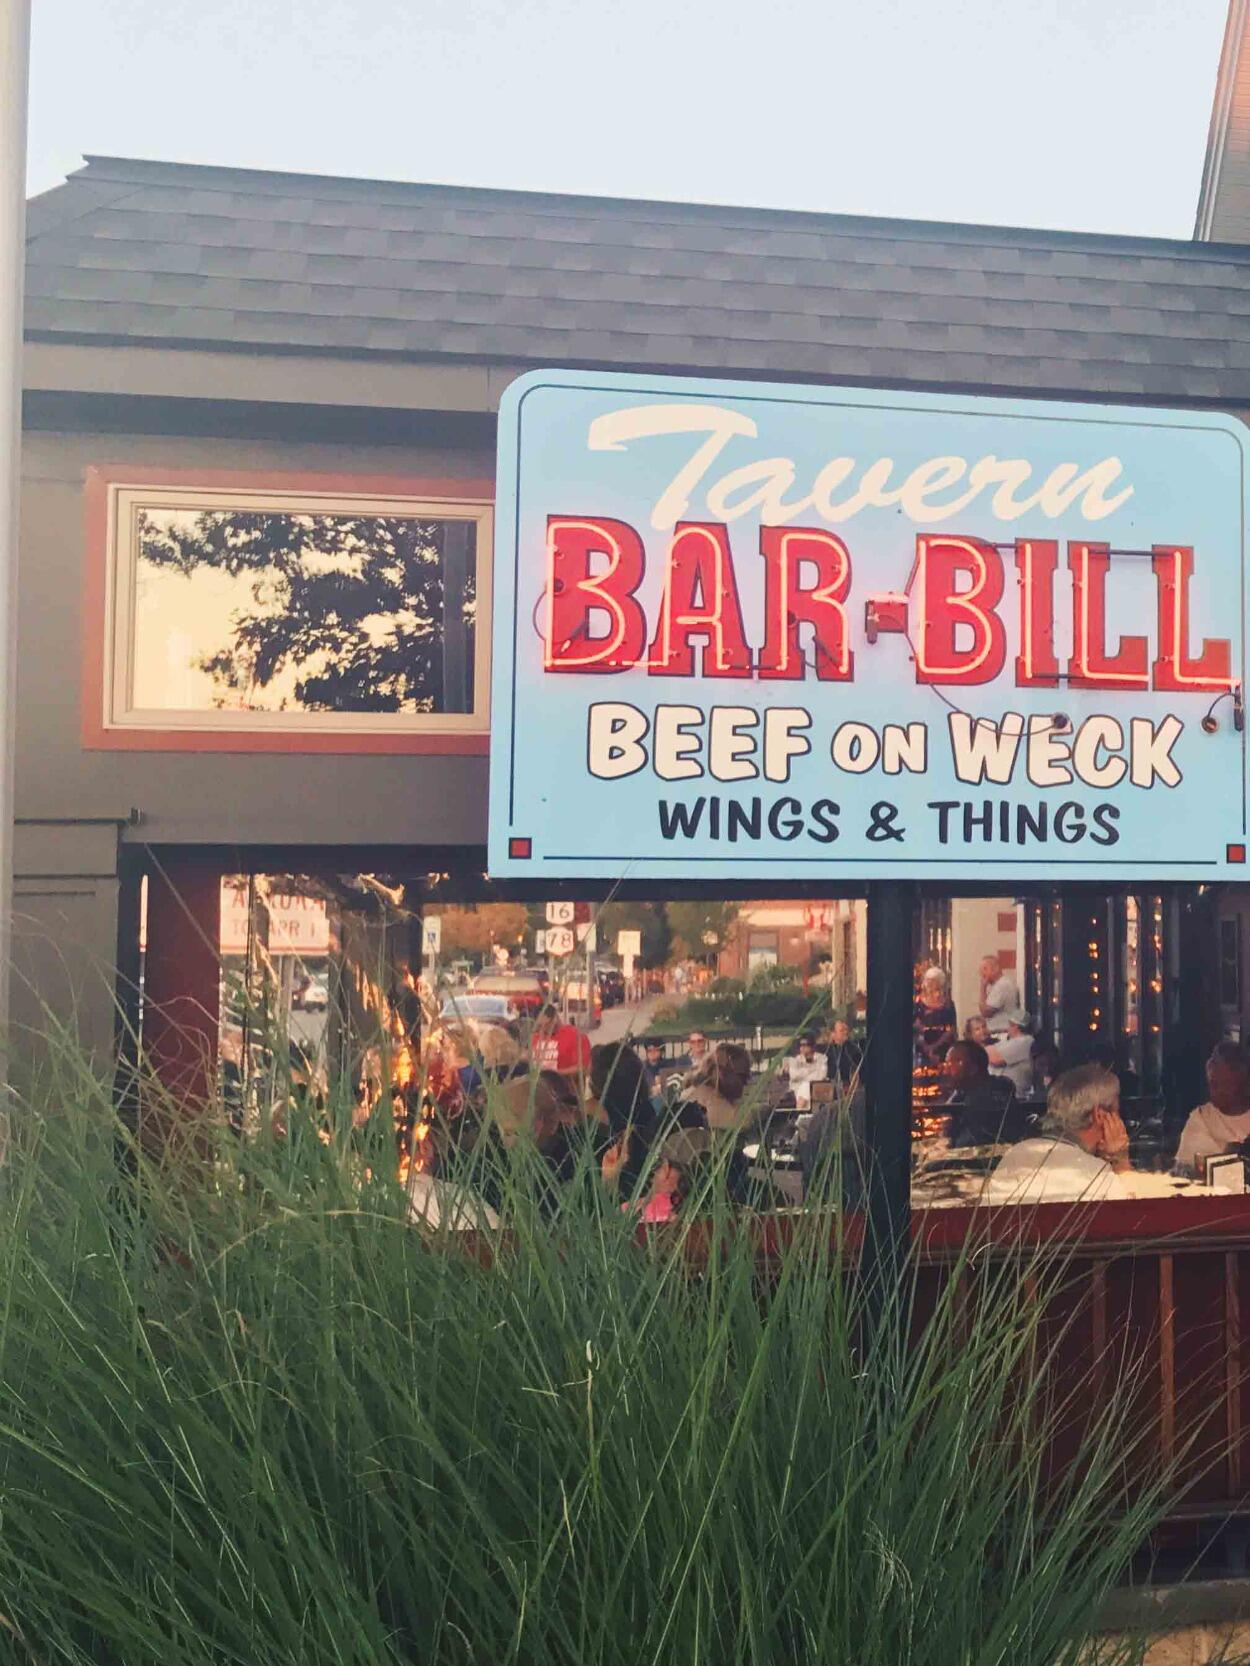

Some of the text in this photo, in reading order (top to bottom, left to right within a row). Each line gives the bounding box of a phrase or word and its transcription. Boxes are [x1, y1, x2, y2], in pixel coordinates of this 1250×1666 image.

[588, 404, 1134, 530] Tavern
[544, 514, 1234, 692] BAR-BILL
[587, 702, 1184, 789] BEEF ON WECK
[658, 798, 1121, 847] WINGS & THINGS
[547, 932, 572, 947] 78
[550, 903, 570, 919] 16
